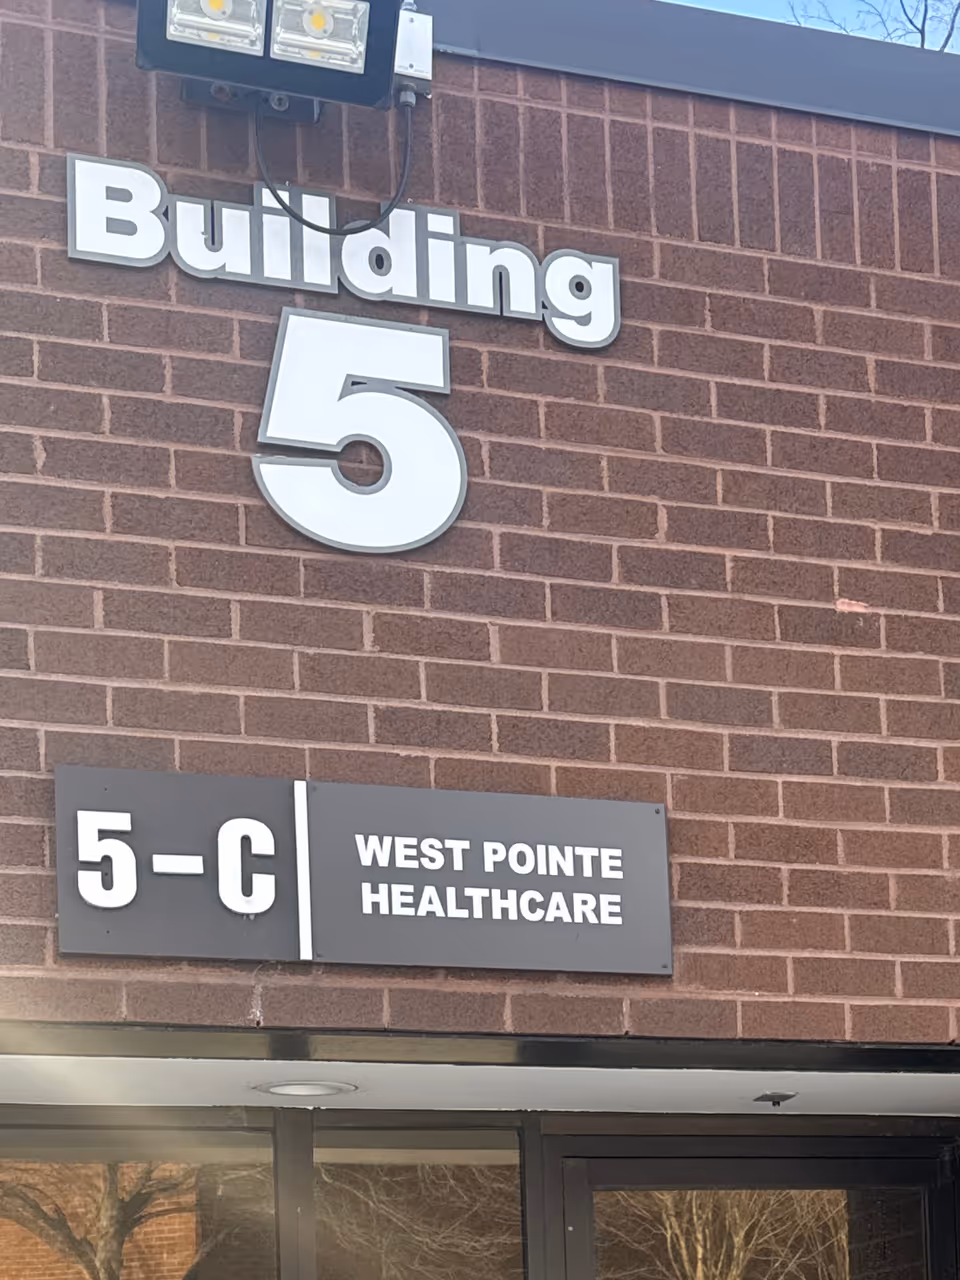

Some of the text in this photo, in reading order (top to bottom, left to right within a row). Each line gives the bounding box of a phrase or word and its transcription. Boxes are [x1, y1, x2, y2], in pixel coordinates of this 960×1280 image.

[68, 154, 620, 348] Building
[252, 307, 467, 552] 5
[354, 834, 623, 879] WEST POINTE
[361, 882, 622, 925] HEALTHCARE
